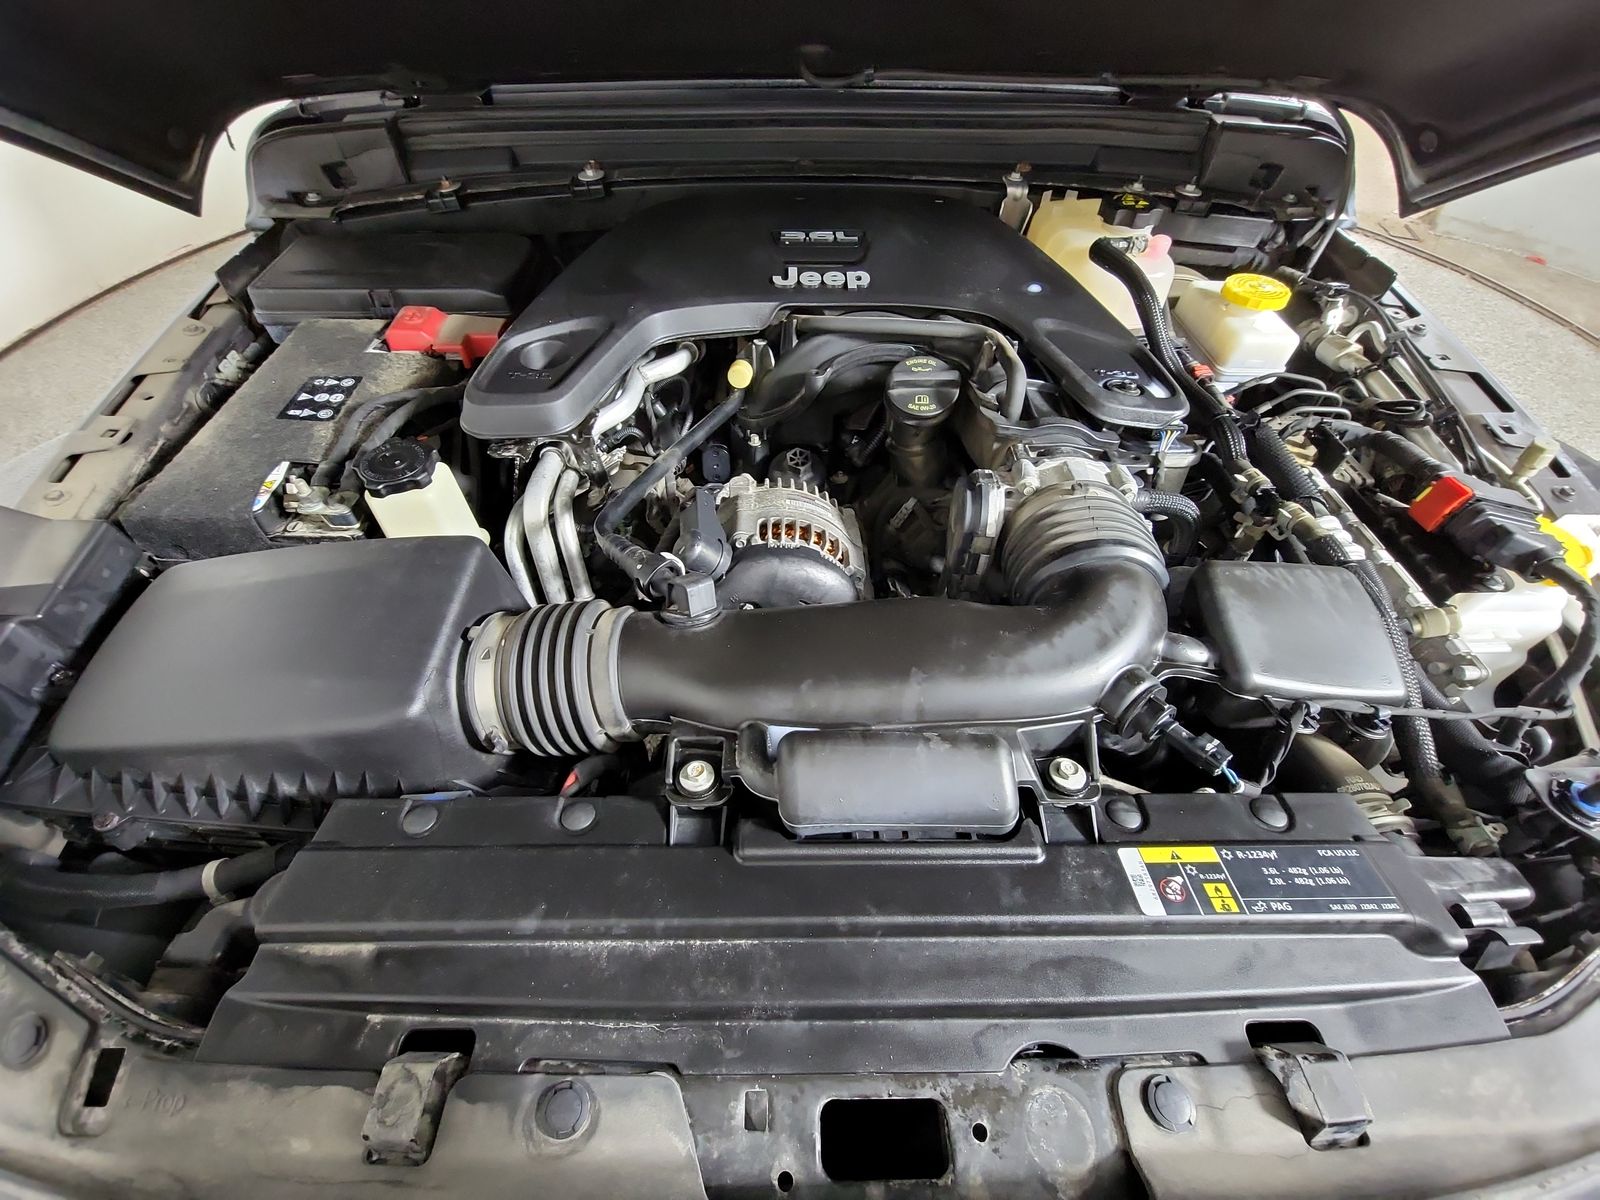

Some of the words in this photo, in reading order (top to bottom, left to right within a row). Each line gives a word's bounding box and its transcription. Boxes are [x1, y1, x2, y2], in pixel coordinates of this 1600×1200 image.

[772, 266, 871, 289] Jeep
[905, 358, 928, 366] ENGINE
[928, 359, 937, 367] OIL
[907, 403, 919, 411] SAE
[1235, 850, 1279, 860] R-1234yf
[1317, 849, 1334, 857] FCA
[1335, 849, 1346, 857] US
[1345, 849, 1360, 857] LLC
[1261, 867, 1280, 875] 3.6L
[1288, 867, 1309, 876] 482g
[1308, 866, 1330, 876] (1.06
[1199, 872, 1227, 881] R-1234yf
[1267, 877, 1287, 886] 2.0L
[1294, 877, 1315, 886] 482g
[1315, 876, 1337, 886] (1.06
[1270, 901, 1293, 912] PAG
[1329, 903, 1342, 911] SAE
